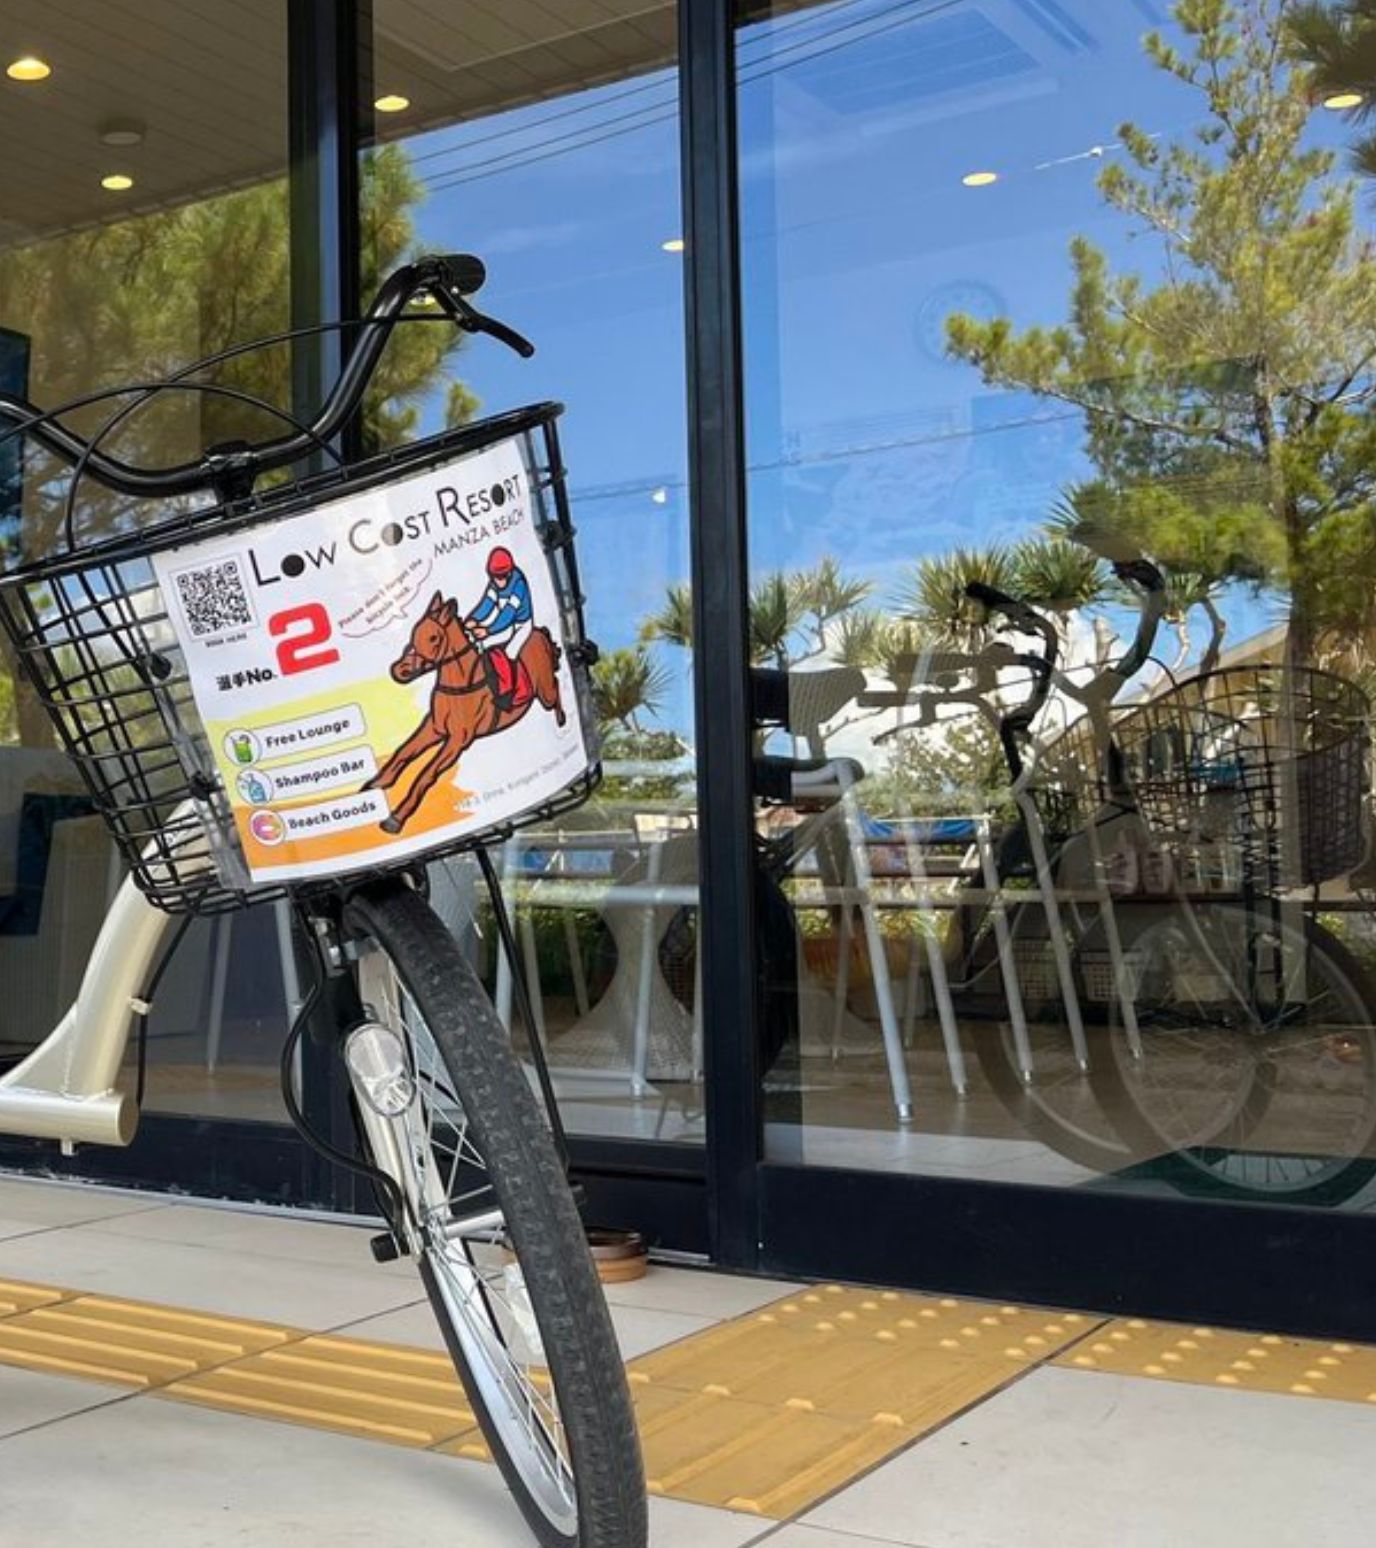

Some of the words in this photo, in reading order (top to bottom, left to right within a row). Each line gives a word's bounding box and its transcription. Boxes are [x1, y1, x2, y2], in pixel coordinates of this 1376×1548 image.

[434, 524, 490, 558] MANZA
[493, 508, 525, 532] BEACH
[269, 603, 340, 676] 2
[265, 733, 296, 748] Free
[298, 719, 350, 740] Lounge
[275, 766, 339, 788] Shampoo
[340, 759, 364, 774] Bar
[288, 812, 330, 829] Beach
[331, 801, 376, 820] Goods
